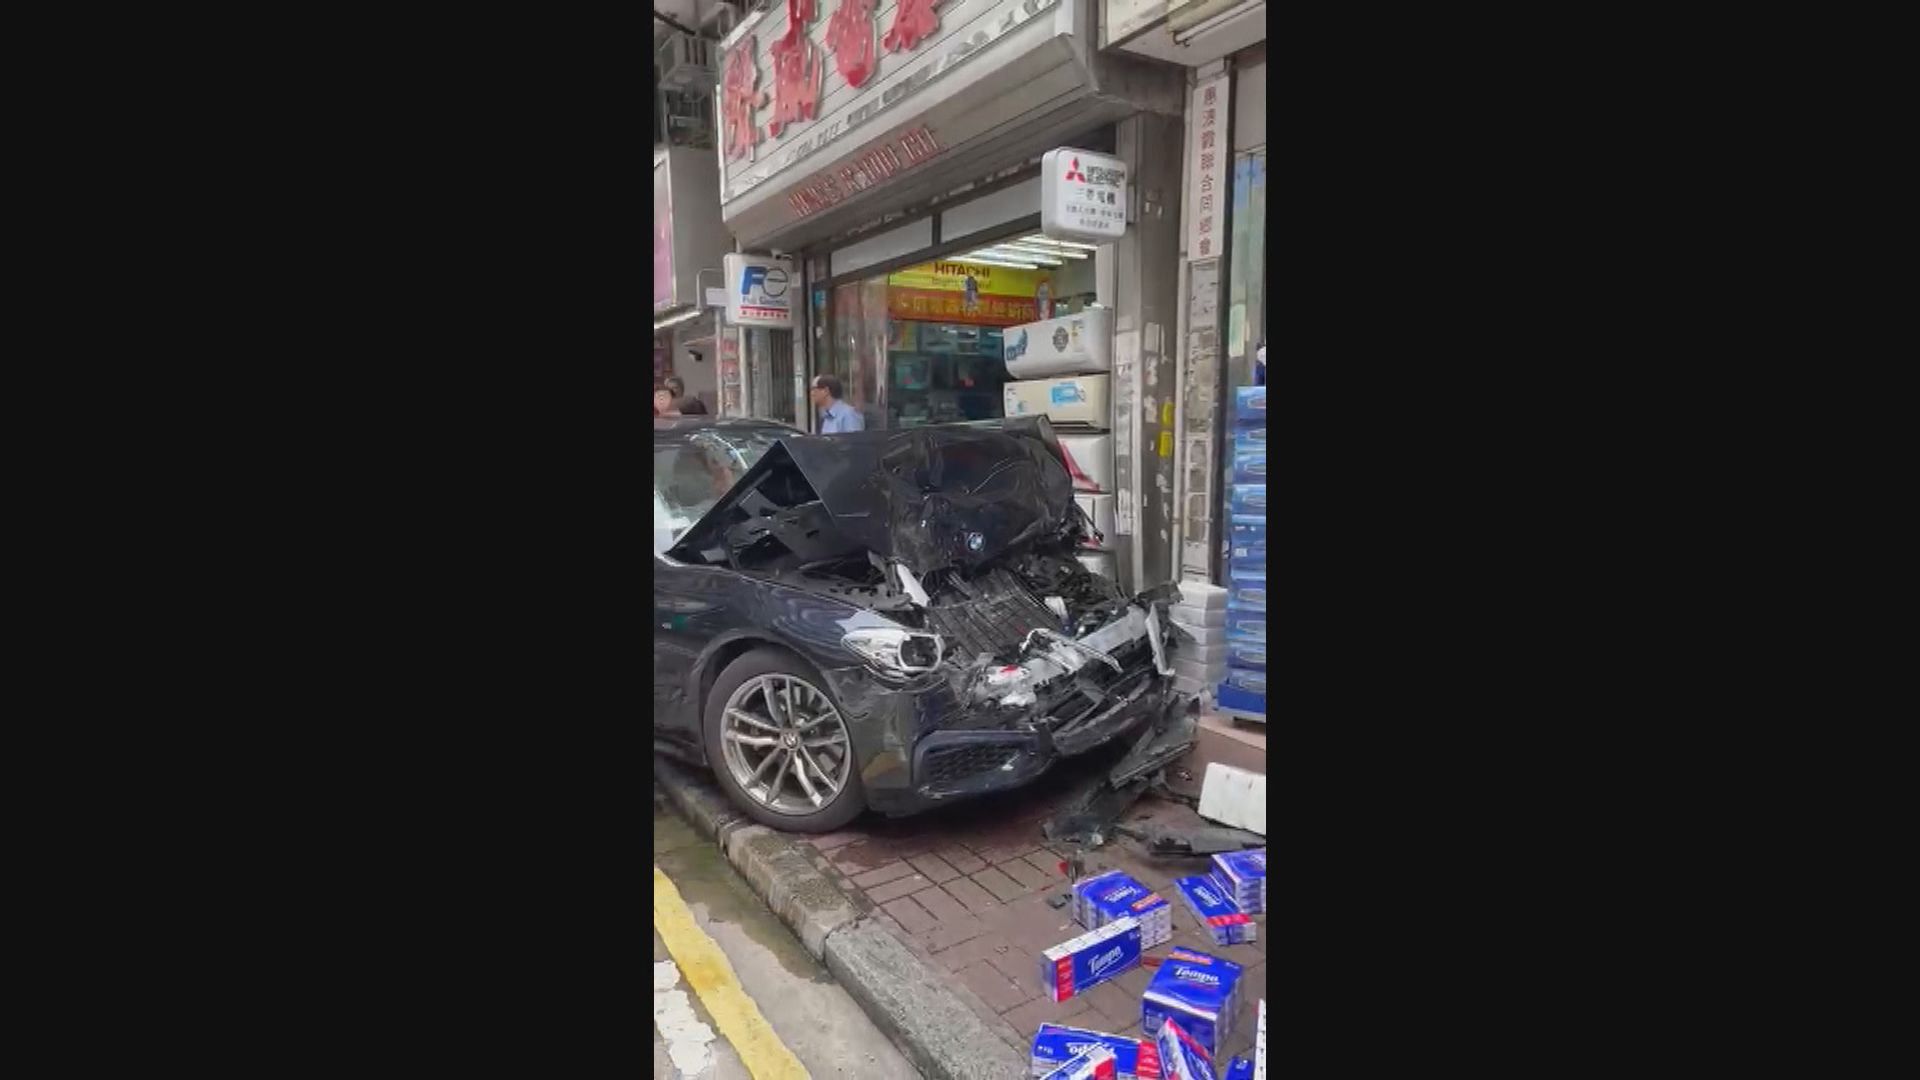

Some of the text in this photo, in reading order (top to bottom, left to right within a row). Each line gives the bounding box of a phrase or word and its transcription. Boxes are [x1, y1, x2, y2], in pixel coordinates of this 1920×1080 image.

[934, 263, 991, 278] HITACHI
[1087, 945, 1124, 976] Tempo
[1174, 965, 1220, 986] Tempo
